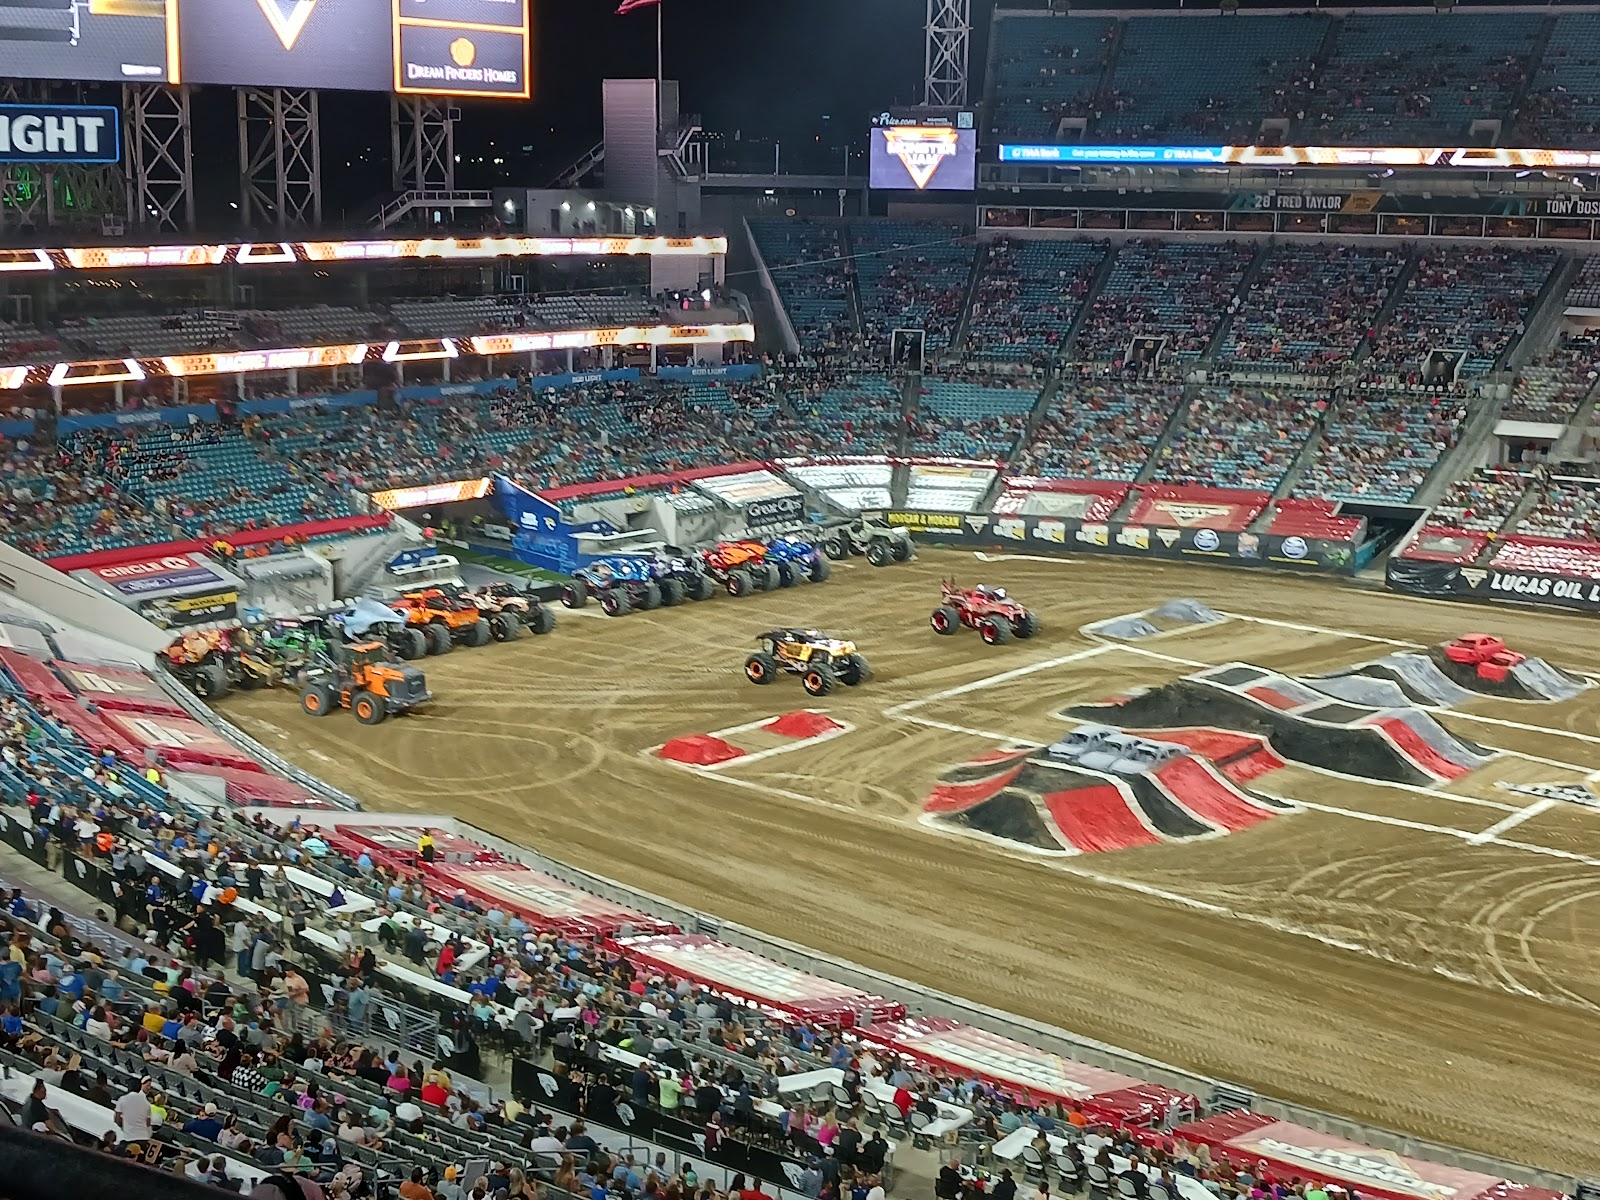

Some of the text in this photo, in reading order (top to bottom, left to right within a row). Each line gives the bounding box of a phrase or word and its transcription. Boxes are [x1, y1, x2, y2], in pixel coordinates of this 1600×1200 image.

[407, 62, 518, 83] DREAM FINDERS HOMES
[1255, 196, 1271, 208] 28
[1277, 196, 1302, 208] FRED
[1306, 196, 1342, 209] TAYLOR
[1546, 200, 1574, 214] TONY
[888, 512, 919, 524] MORGAN
[927, 514, 960, 527] MORGAN
[99, 562, 165, 578] CIRCLE
[1490, 573, 1552, 596] LUCAS
[1552, 580, 1585, 601] OIL
